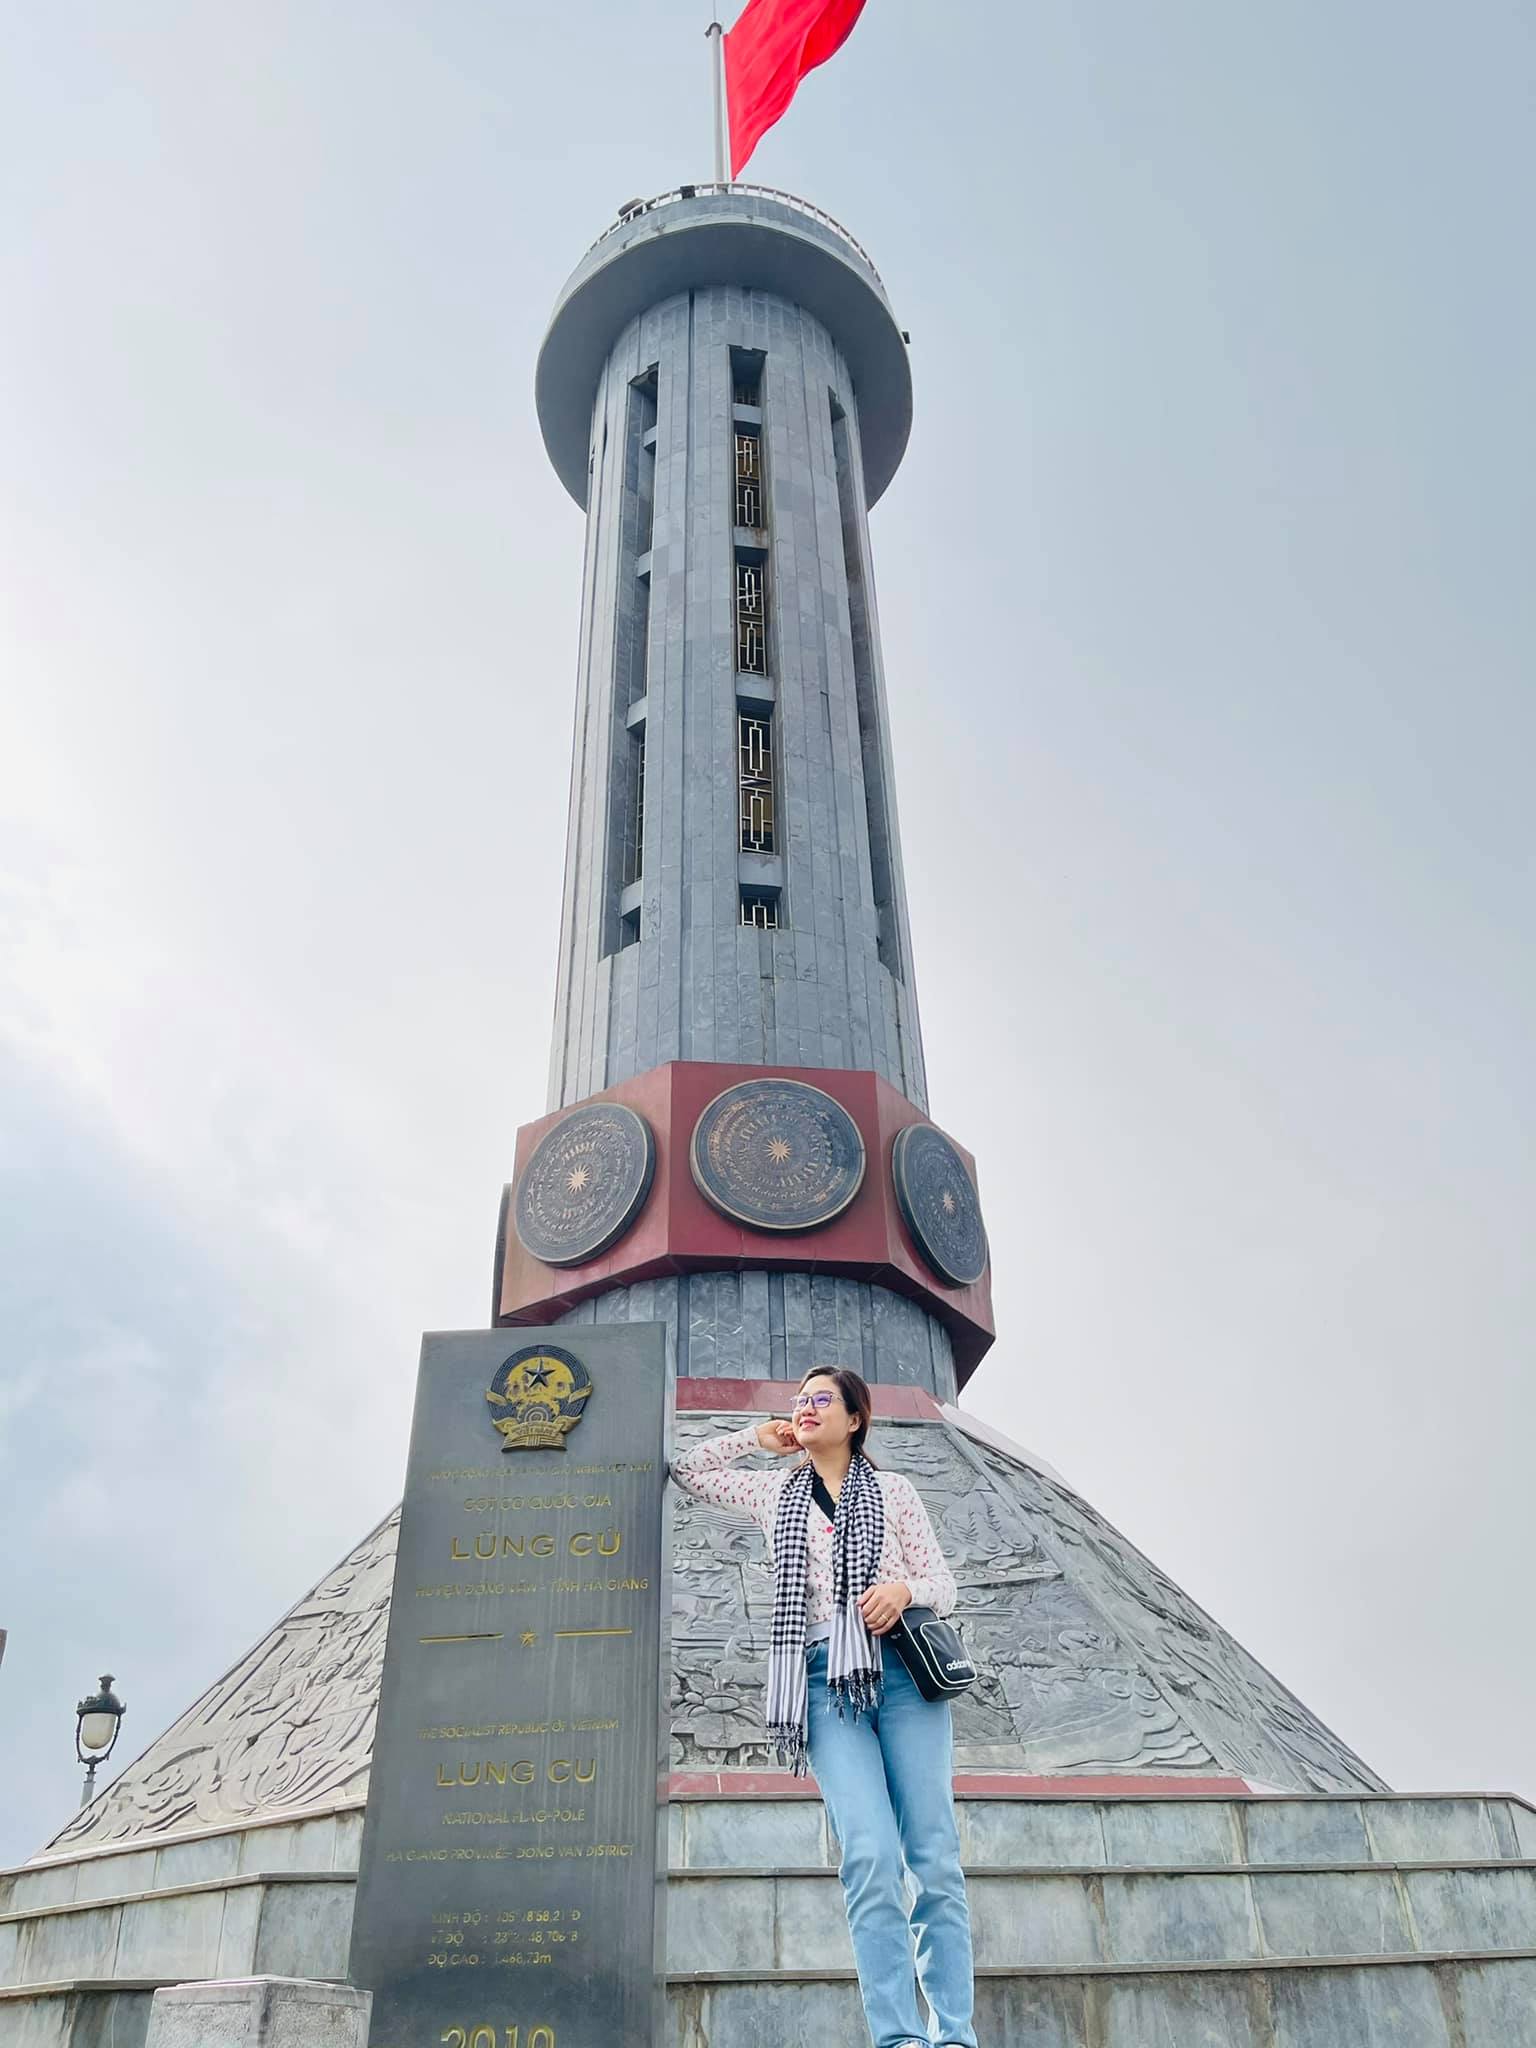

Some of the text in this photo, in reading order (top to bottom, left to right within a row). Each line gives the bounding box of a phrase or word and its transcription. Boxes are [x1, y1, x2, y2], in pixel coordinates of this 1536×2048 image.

[607, 1577, 648, 1592] GIANG
[437, 1758, 596, 1787] LUNG CU
[442, 1810, 509, 1825] NATIONAL
[586, 1842, 633, 1857] DISTRICT
[440, 2022, 556, 2048] 2010
